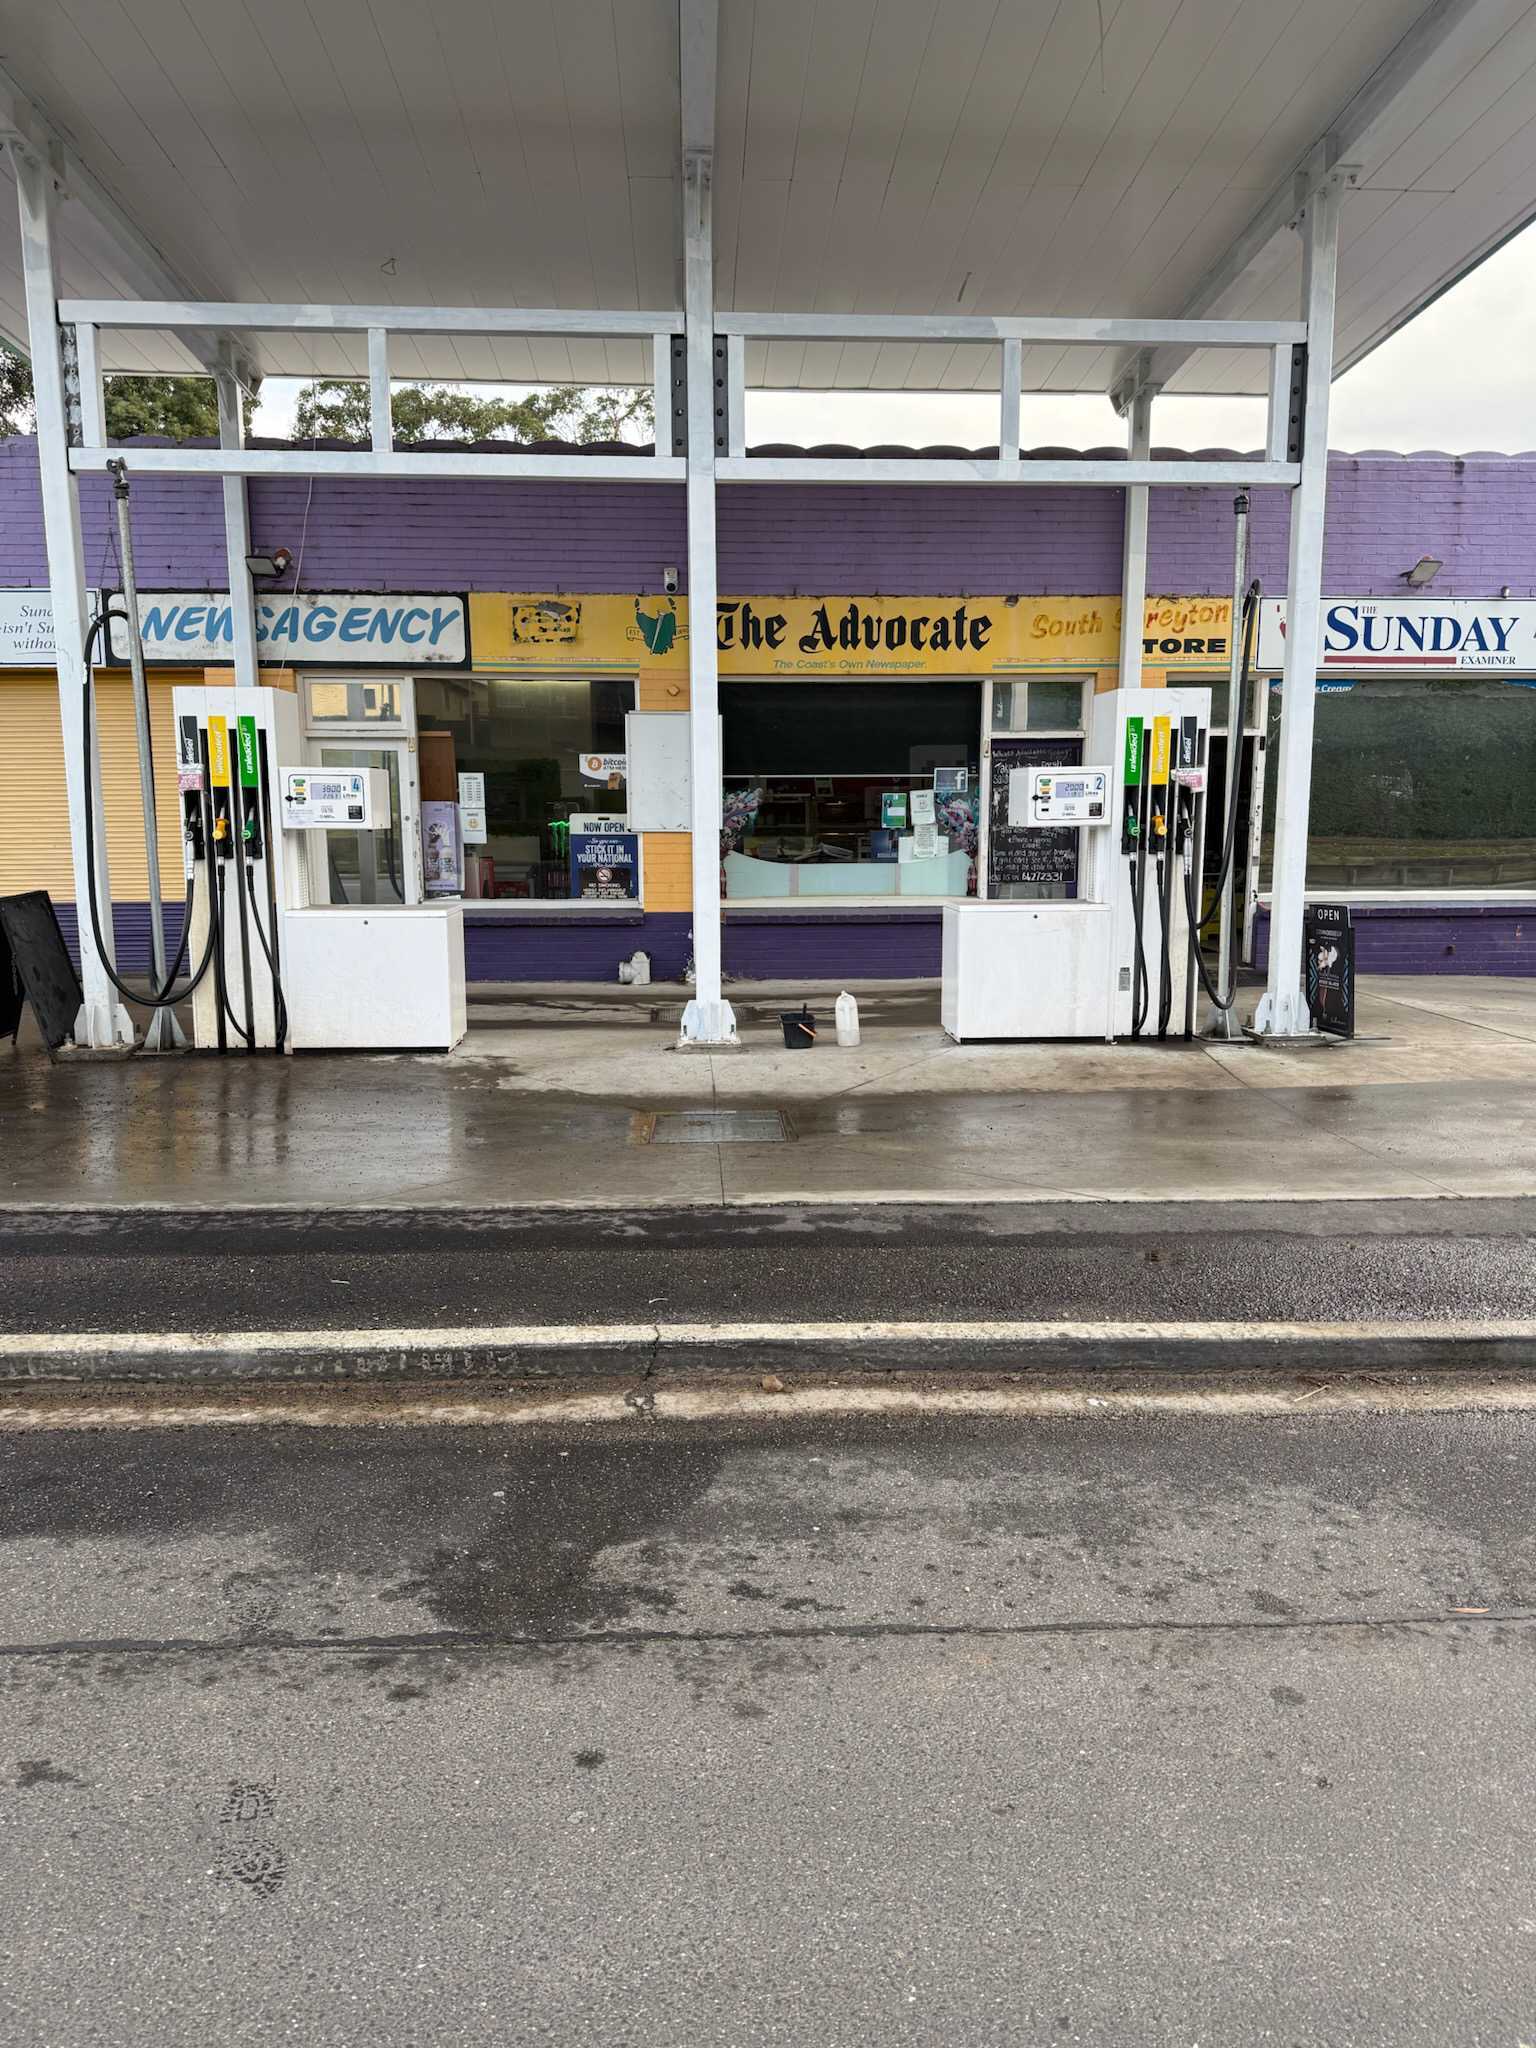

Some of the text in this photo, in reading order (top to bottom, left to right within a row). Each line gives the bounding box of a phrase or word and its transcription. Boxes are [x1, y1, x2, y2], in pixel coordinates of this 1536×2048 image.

[717, 602, 992, 653] The Advocate
[1324, 605, 1520, 652] SUNDAY
[1142, 638, 1227, 654] TORE
[774, 659, 793, 669] The
[796, 659, 835, 669] Coast's
[839, 659, 863, 669] Own
[1461, 656, 1516, 665] EXAMINER
[1096, 776, 1103, 790] 2
[583, 822, 625, 833] NOW OPEN
[1318, 909, 1340, 920] OPEN
